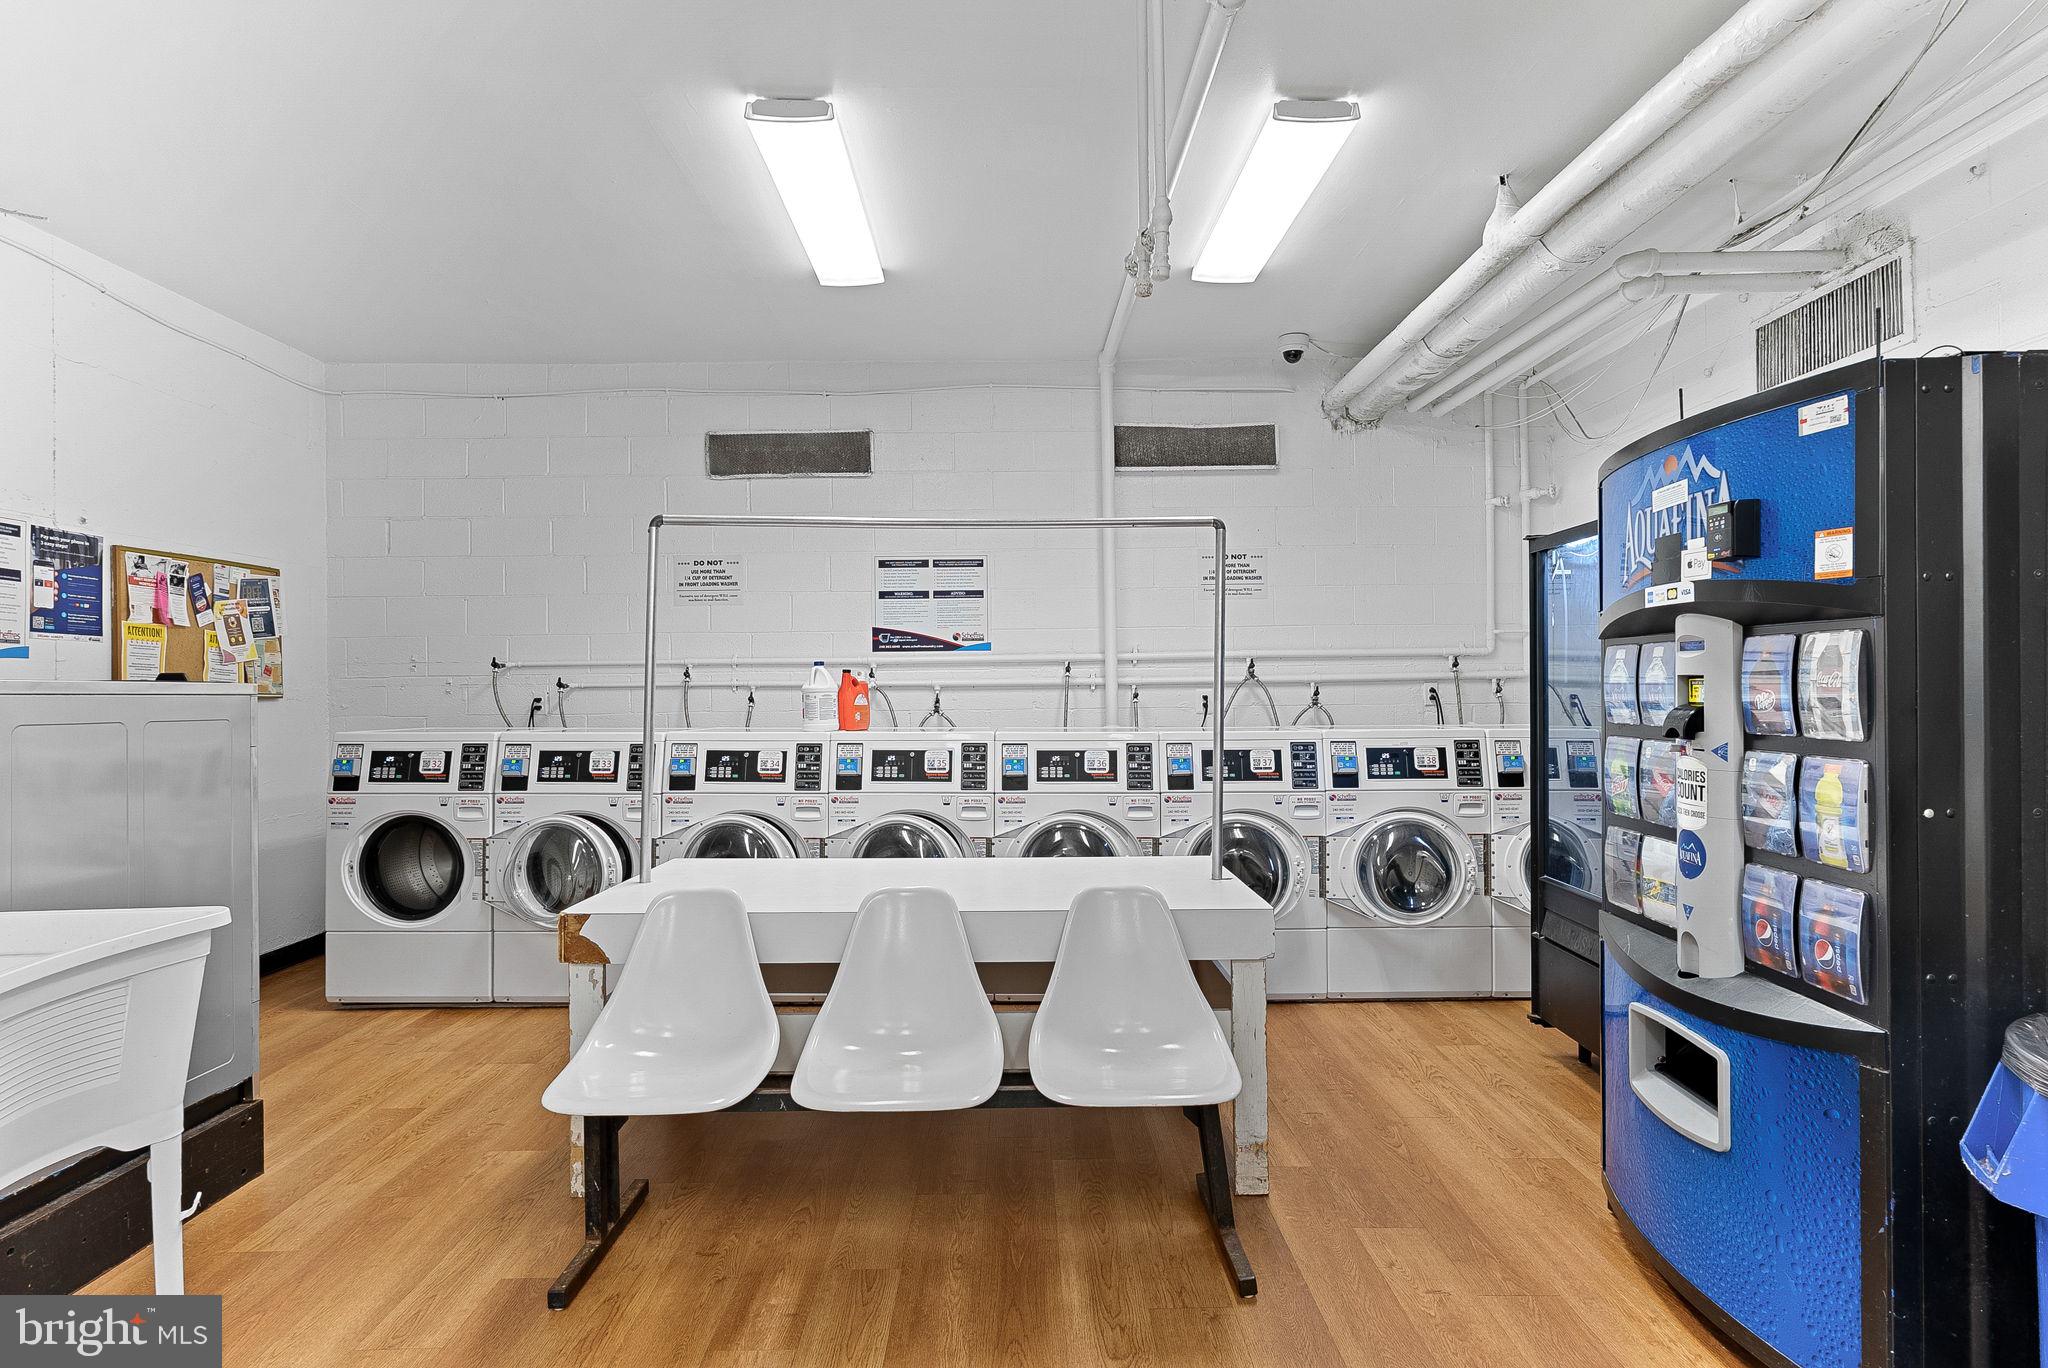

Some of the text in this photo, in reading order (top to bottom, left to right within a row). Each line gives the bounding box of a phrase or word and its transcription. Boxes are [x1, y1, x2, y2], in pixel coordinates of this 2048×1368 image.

[1693, 559, 1706, 569] Pay
[1681, 588, 1691, 596] VISA
[127, 625, 163, 638] ATTENTION!
[431, 760, 442, 768] 32
[601, 760, 612, 768] 33
[769, 760, 780, 768] 34
[937, 759, 947, 768] 35
[1096, 760, 1107, 768] 36
[1262, 759, 1273, 767] 37
[1426, 756, 1437, 764] 38
[1834, 946, 1842, 973] pepsi
